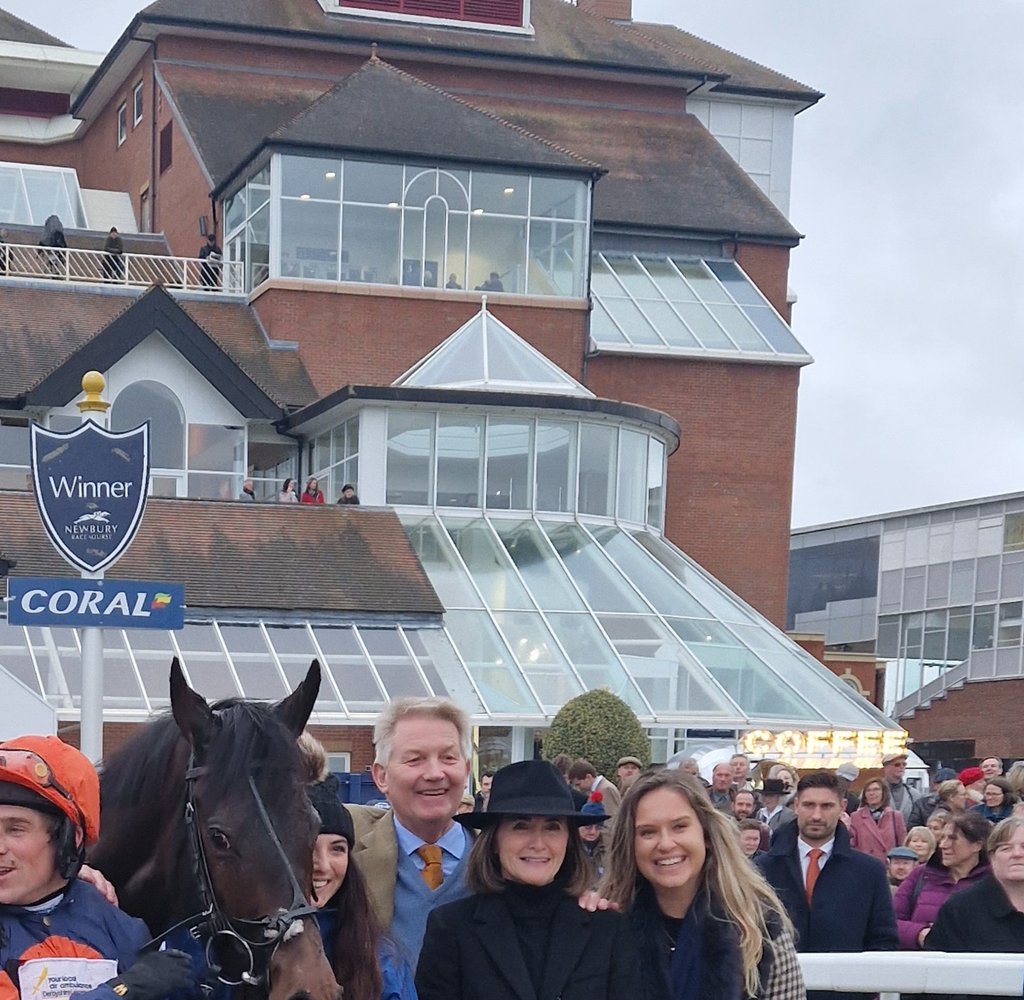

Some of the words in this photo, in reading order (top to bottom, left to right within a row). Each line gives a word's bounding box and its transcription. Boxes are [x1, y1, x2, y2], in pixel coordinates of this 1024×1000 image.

[49, 475, 133, 498] Winner
[65, 525, 118, 534] NEWBURY
[21, 589, 151, 617] CORAL
[742, 729, 908, 755] COFFEE
